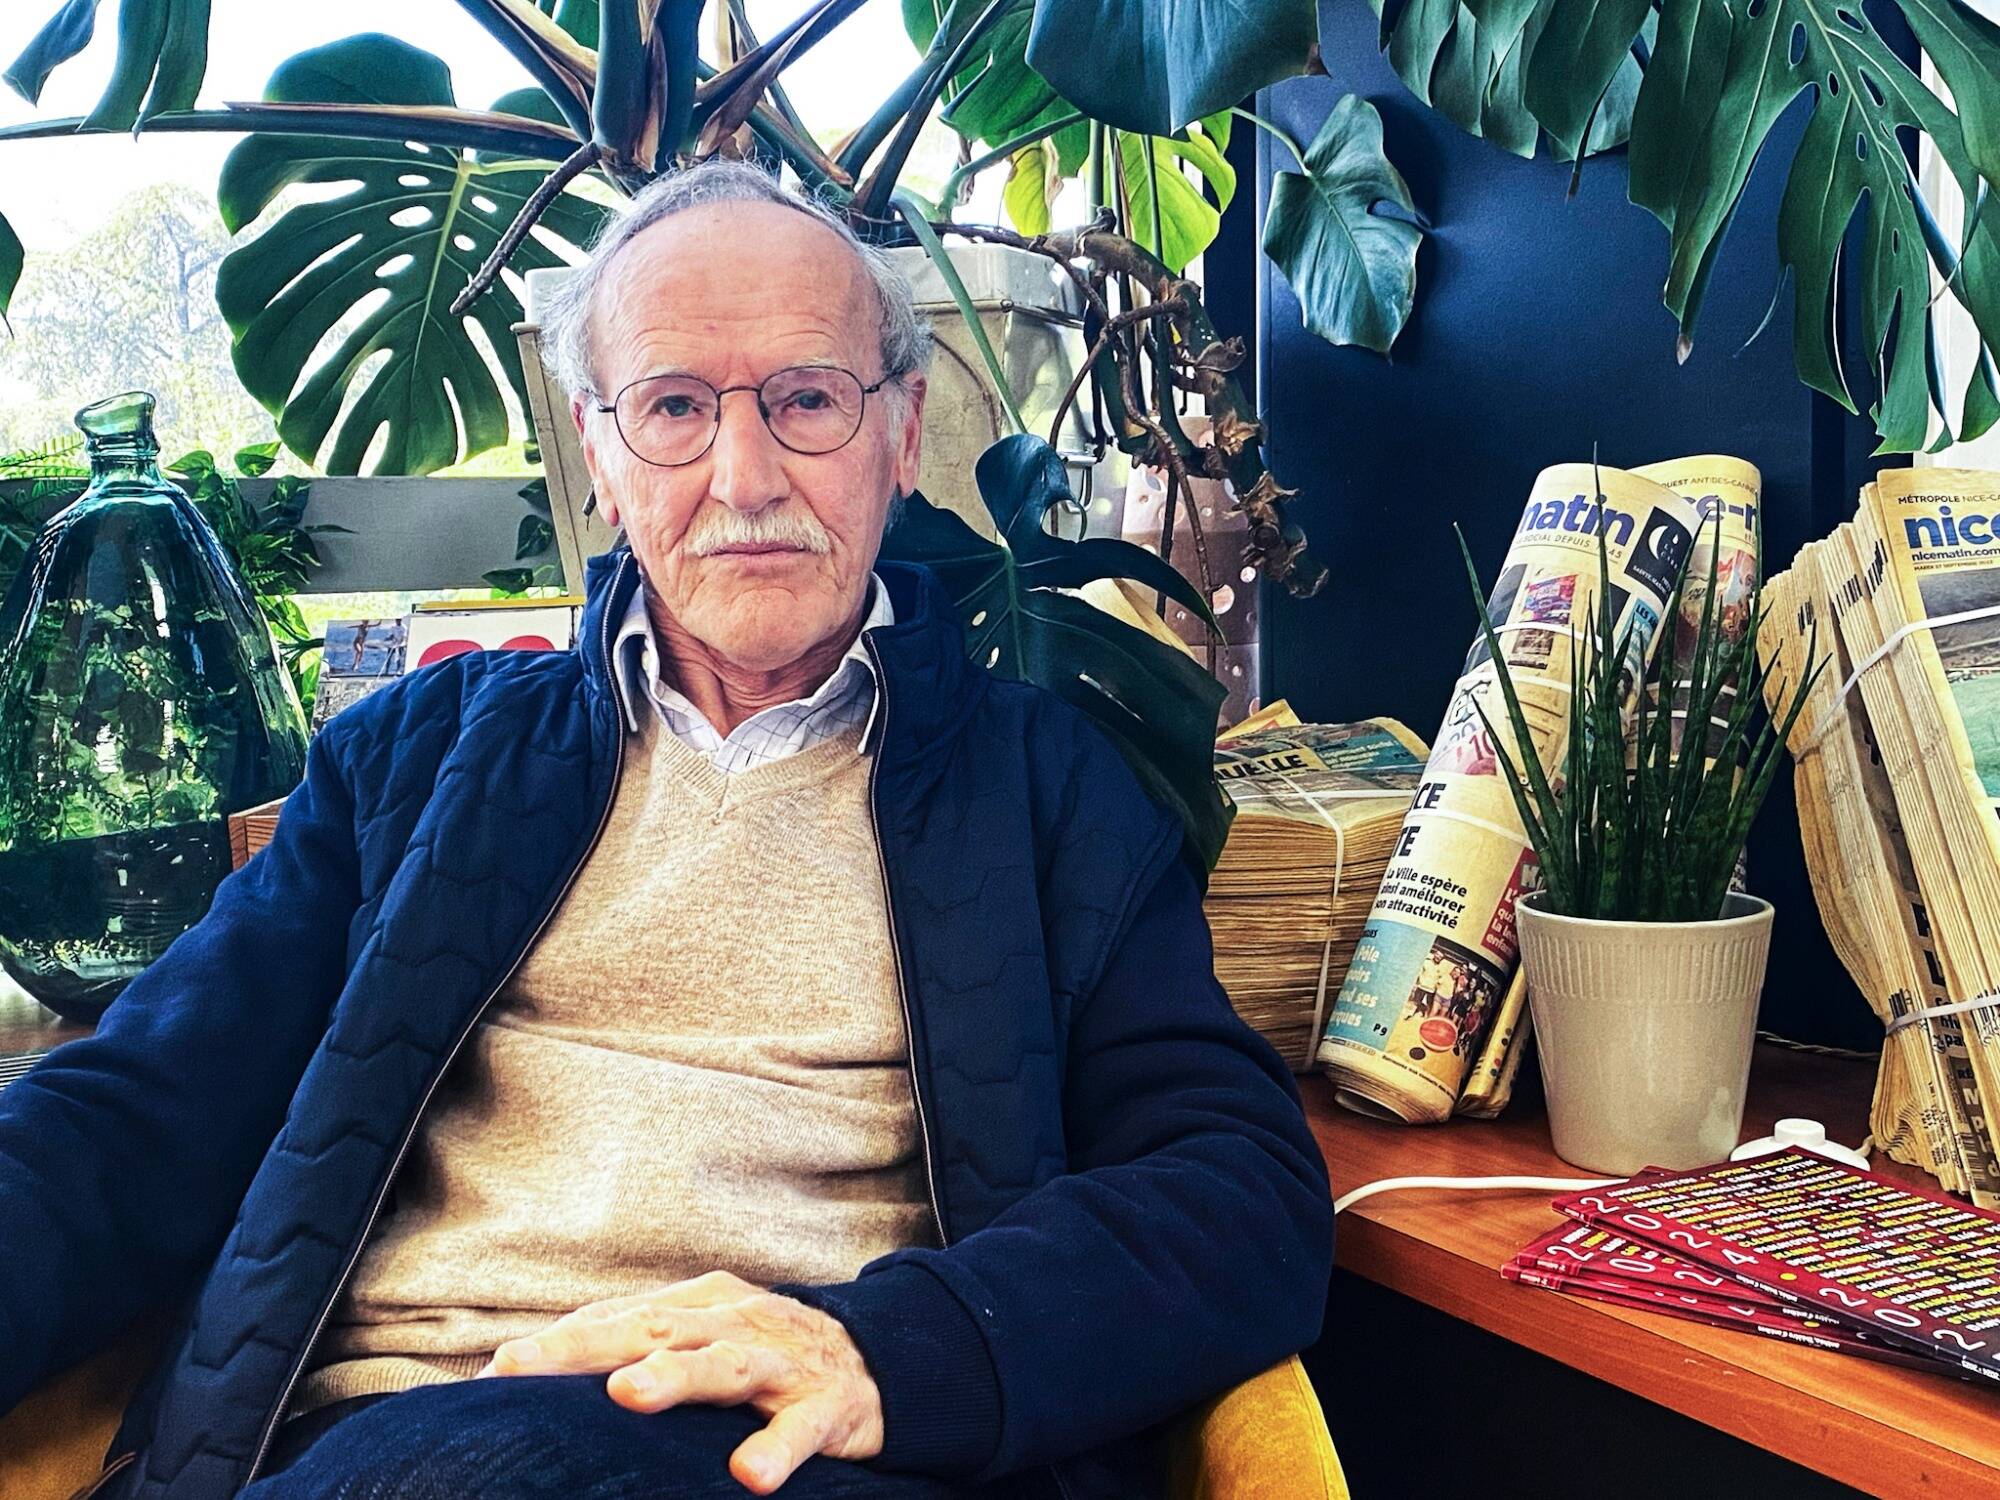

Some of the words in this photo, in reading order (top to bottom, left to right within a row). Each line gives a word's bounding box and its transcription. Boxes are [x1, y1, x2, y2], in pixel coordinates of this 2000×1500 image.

[1898, 495, 1960, 505] MÉTROPOLE
[1554, 536, 1591, 548] DEPUIS
[1635, 604, 1649, 619] LES
[1396, 867, 1419, 882] Ville
[1420, 874, 1469, 899] espère
[1399, 885, 1467, 914] améliorer
[1387, 898, 1458, 931] attractivité
[1356, 991, 1379, 1009] ses
[1727, 1170, 1776, 1183] CAMILLE
[1775, 1159, 1818, 1173] COTTIN
[1647, 1205, 1674, 1213] GAD
[1691, 1223, 1712, 1231] LA
[1745, 1226, 1775, 1236] VAN
[1871, 1223, 1926, 1238] CHARLES
[1890, 1288, 1944, 1305] GÉRARD
[1929, 1304, 1966, 1318] ALEX
